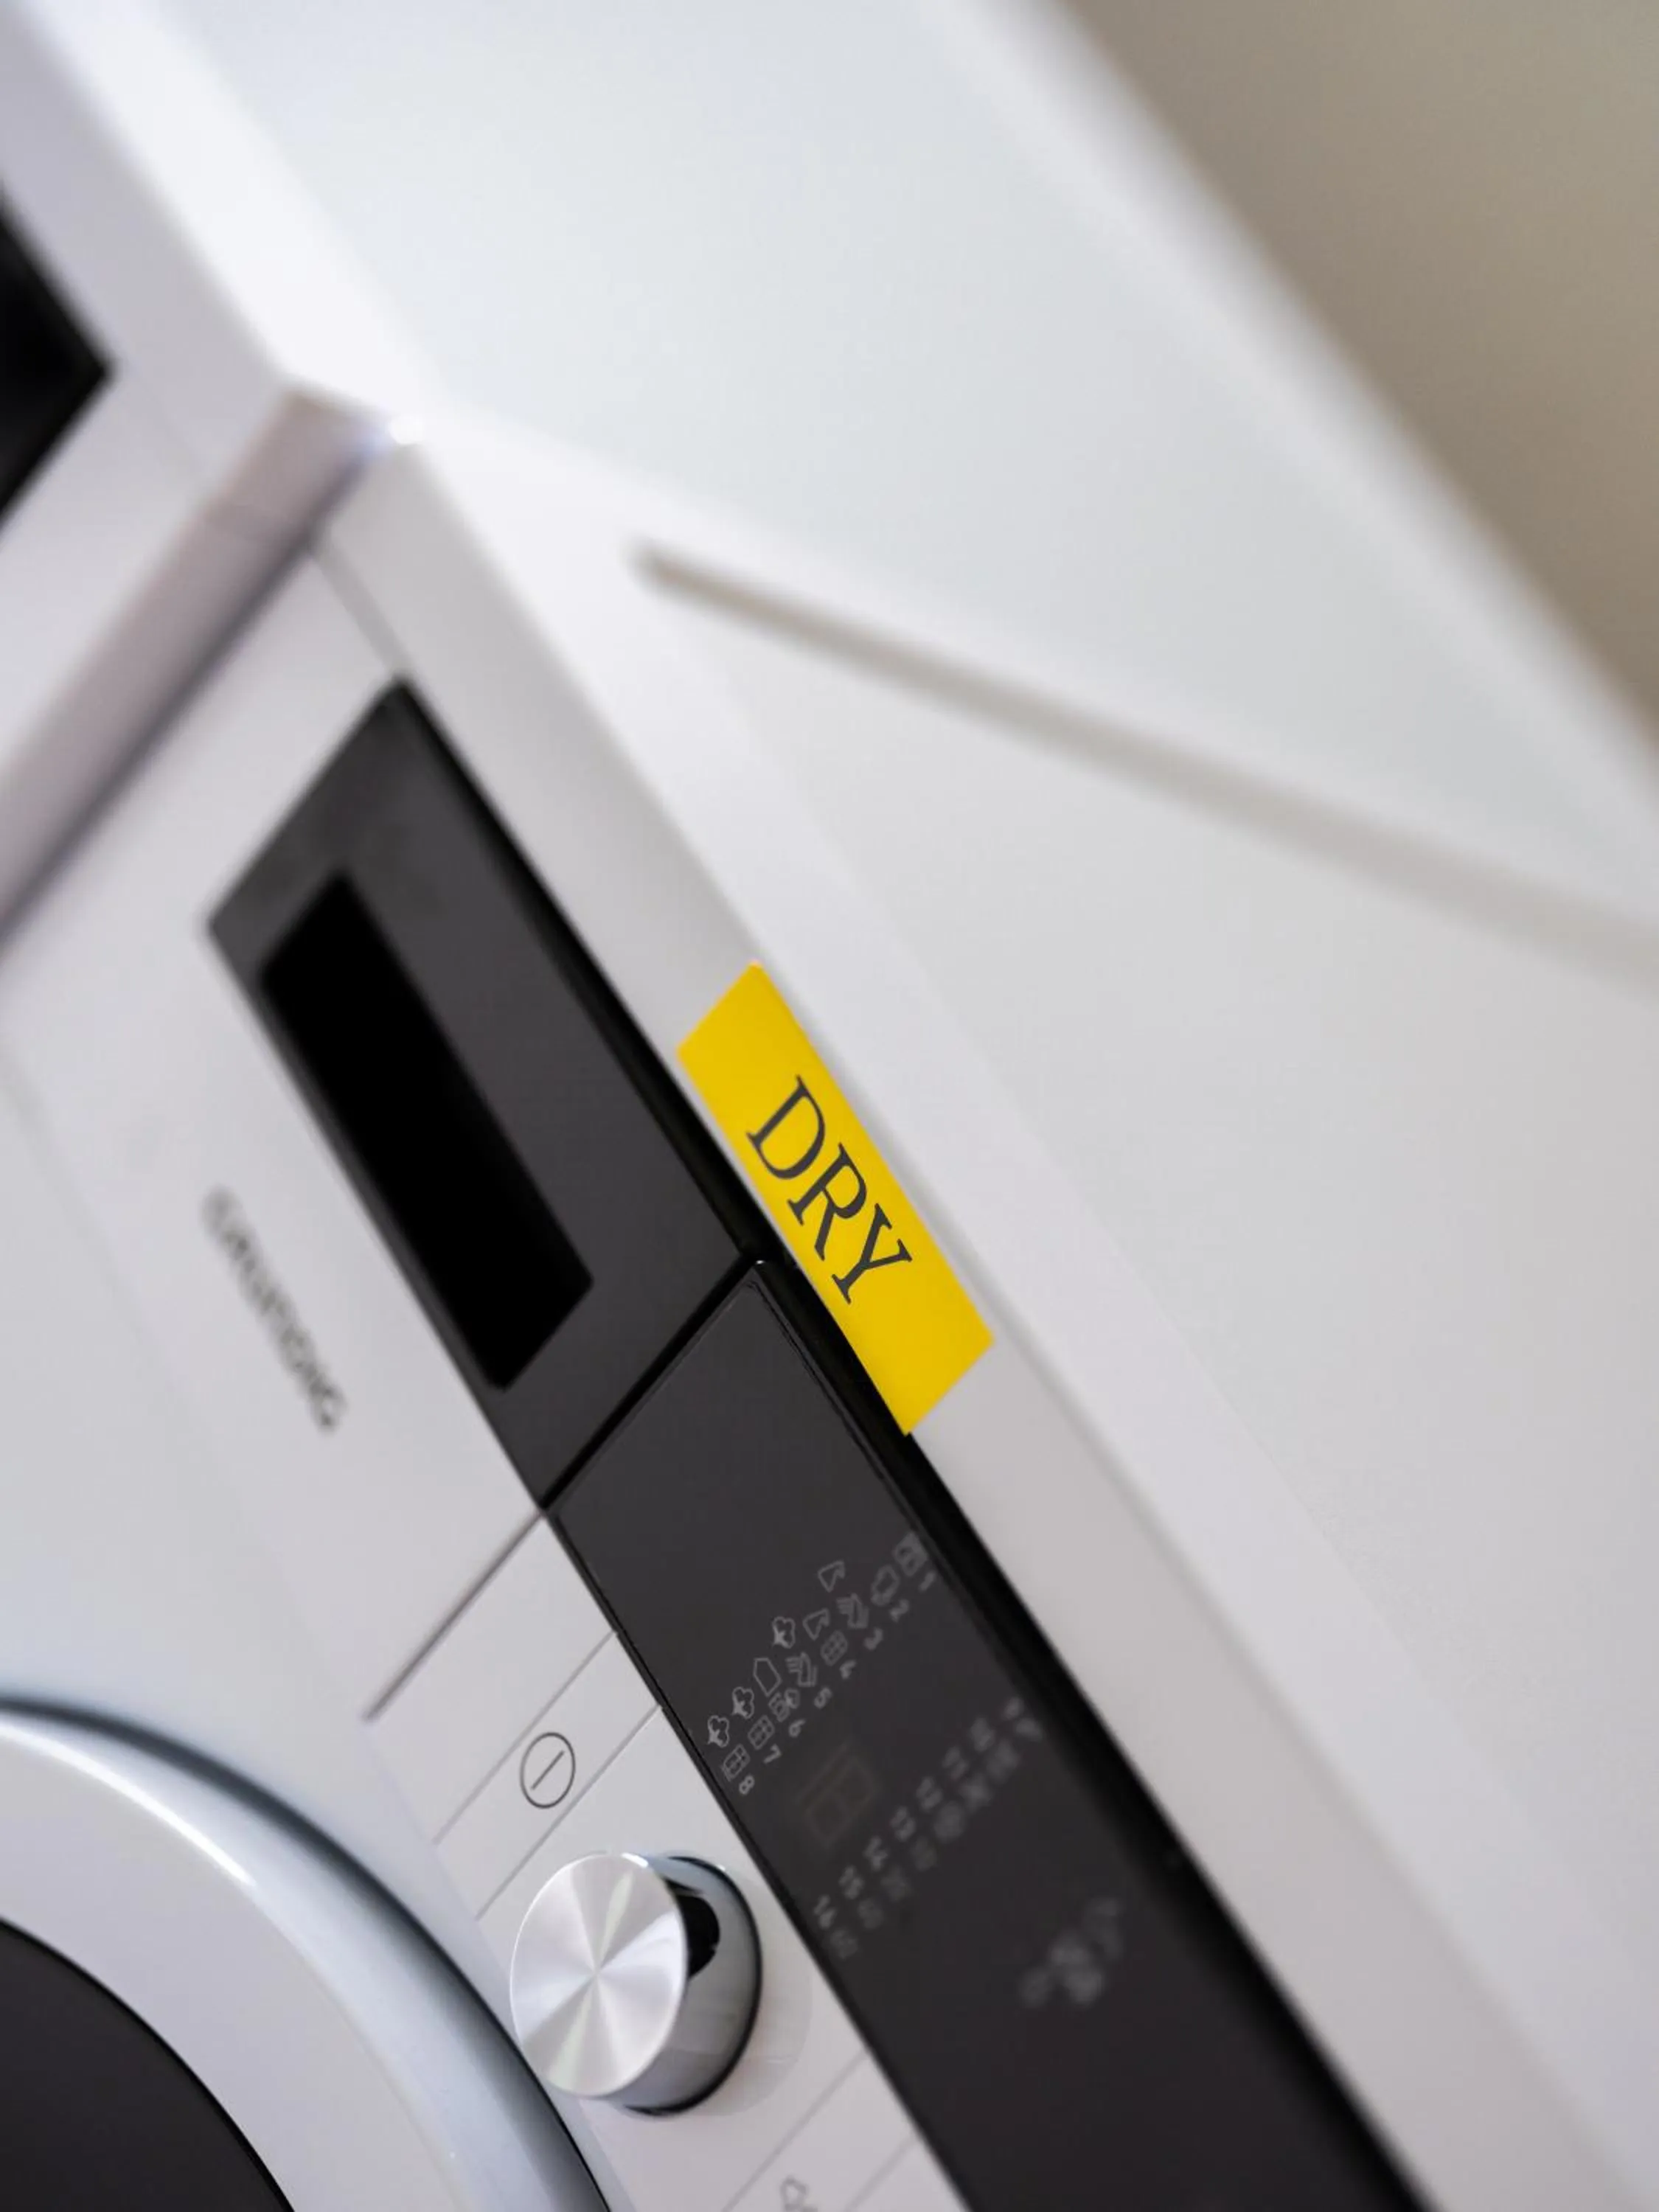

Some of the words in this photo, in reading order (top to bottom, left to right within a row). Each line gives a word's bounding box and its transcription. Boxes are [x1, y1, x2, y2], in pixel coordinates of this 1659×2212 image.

[745, 1075, 912, 1304] DRY
[864, 1628, 885, 1651] 3
[839, 1660, 858, 1680] 4
[814, 1688, 832, 1708] 5
[788, 1719, 806, 1739] 6
[764, 1743, 782, 1765] 7
[739, 1775, 756, 1795] 8
